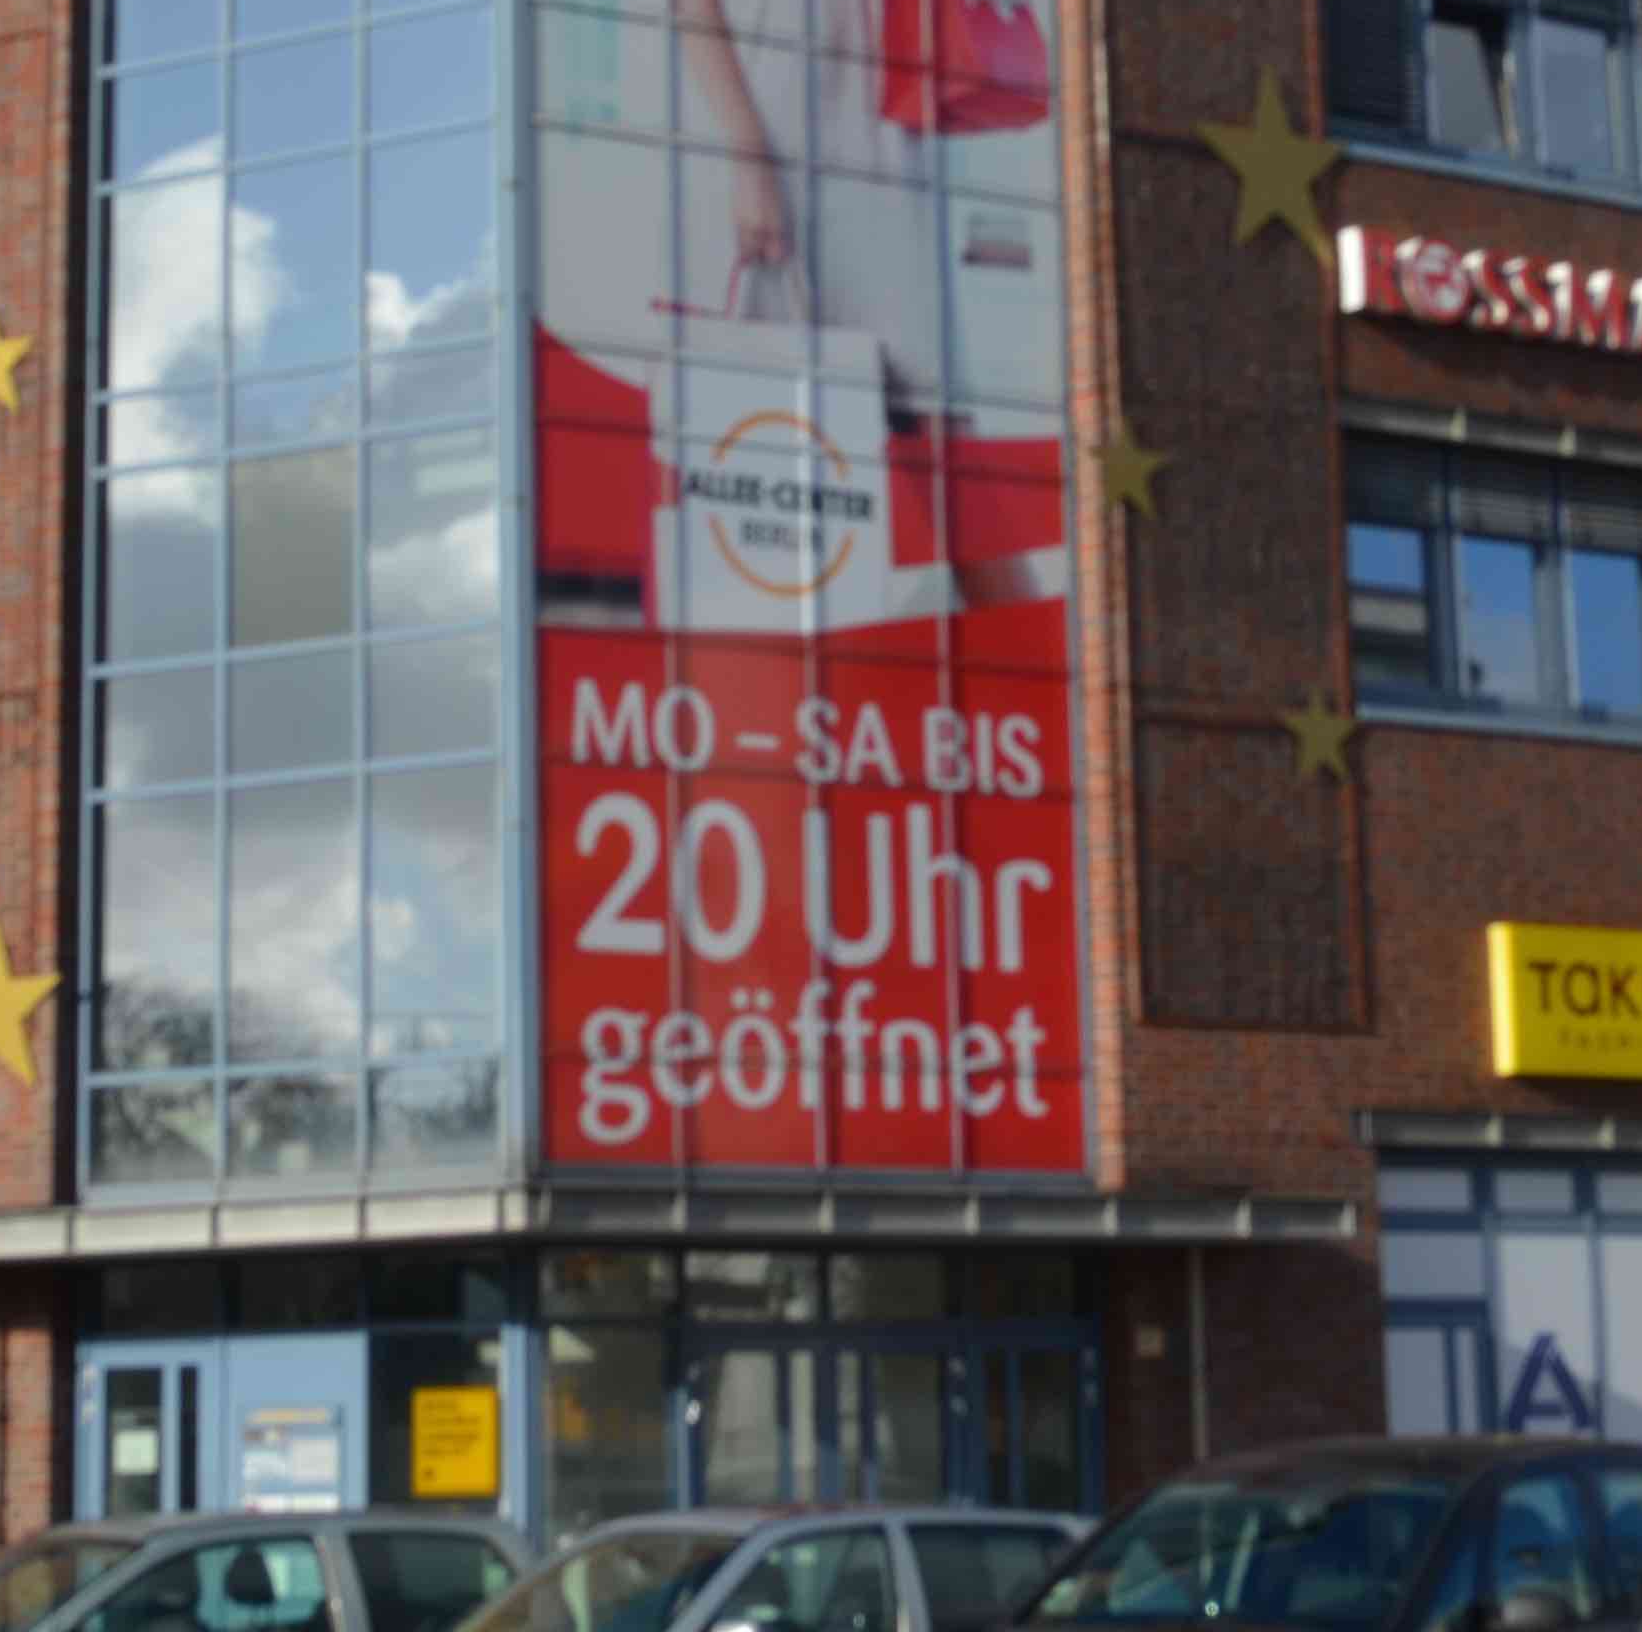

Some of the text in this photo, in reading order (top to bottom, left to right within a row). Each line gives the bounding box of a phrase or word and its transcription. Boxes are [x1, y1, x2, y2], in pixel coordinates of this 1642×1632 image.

[570, 676, 716, 772] MO
[794, 696, 903, 787] SA
[921, 708, 1043, 799] BIS
[575, 789, 1052, 974] 20 Uhr
[576, 978, 1050, 1146] geöffnet
